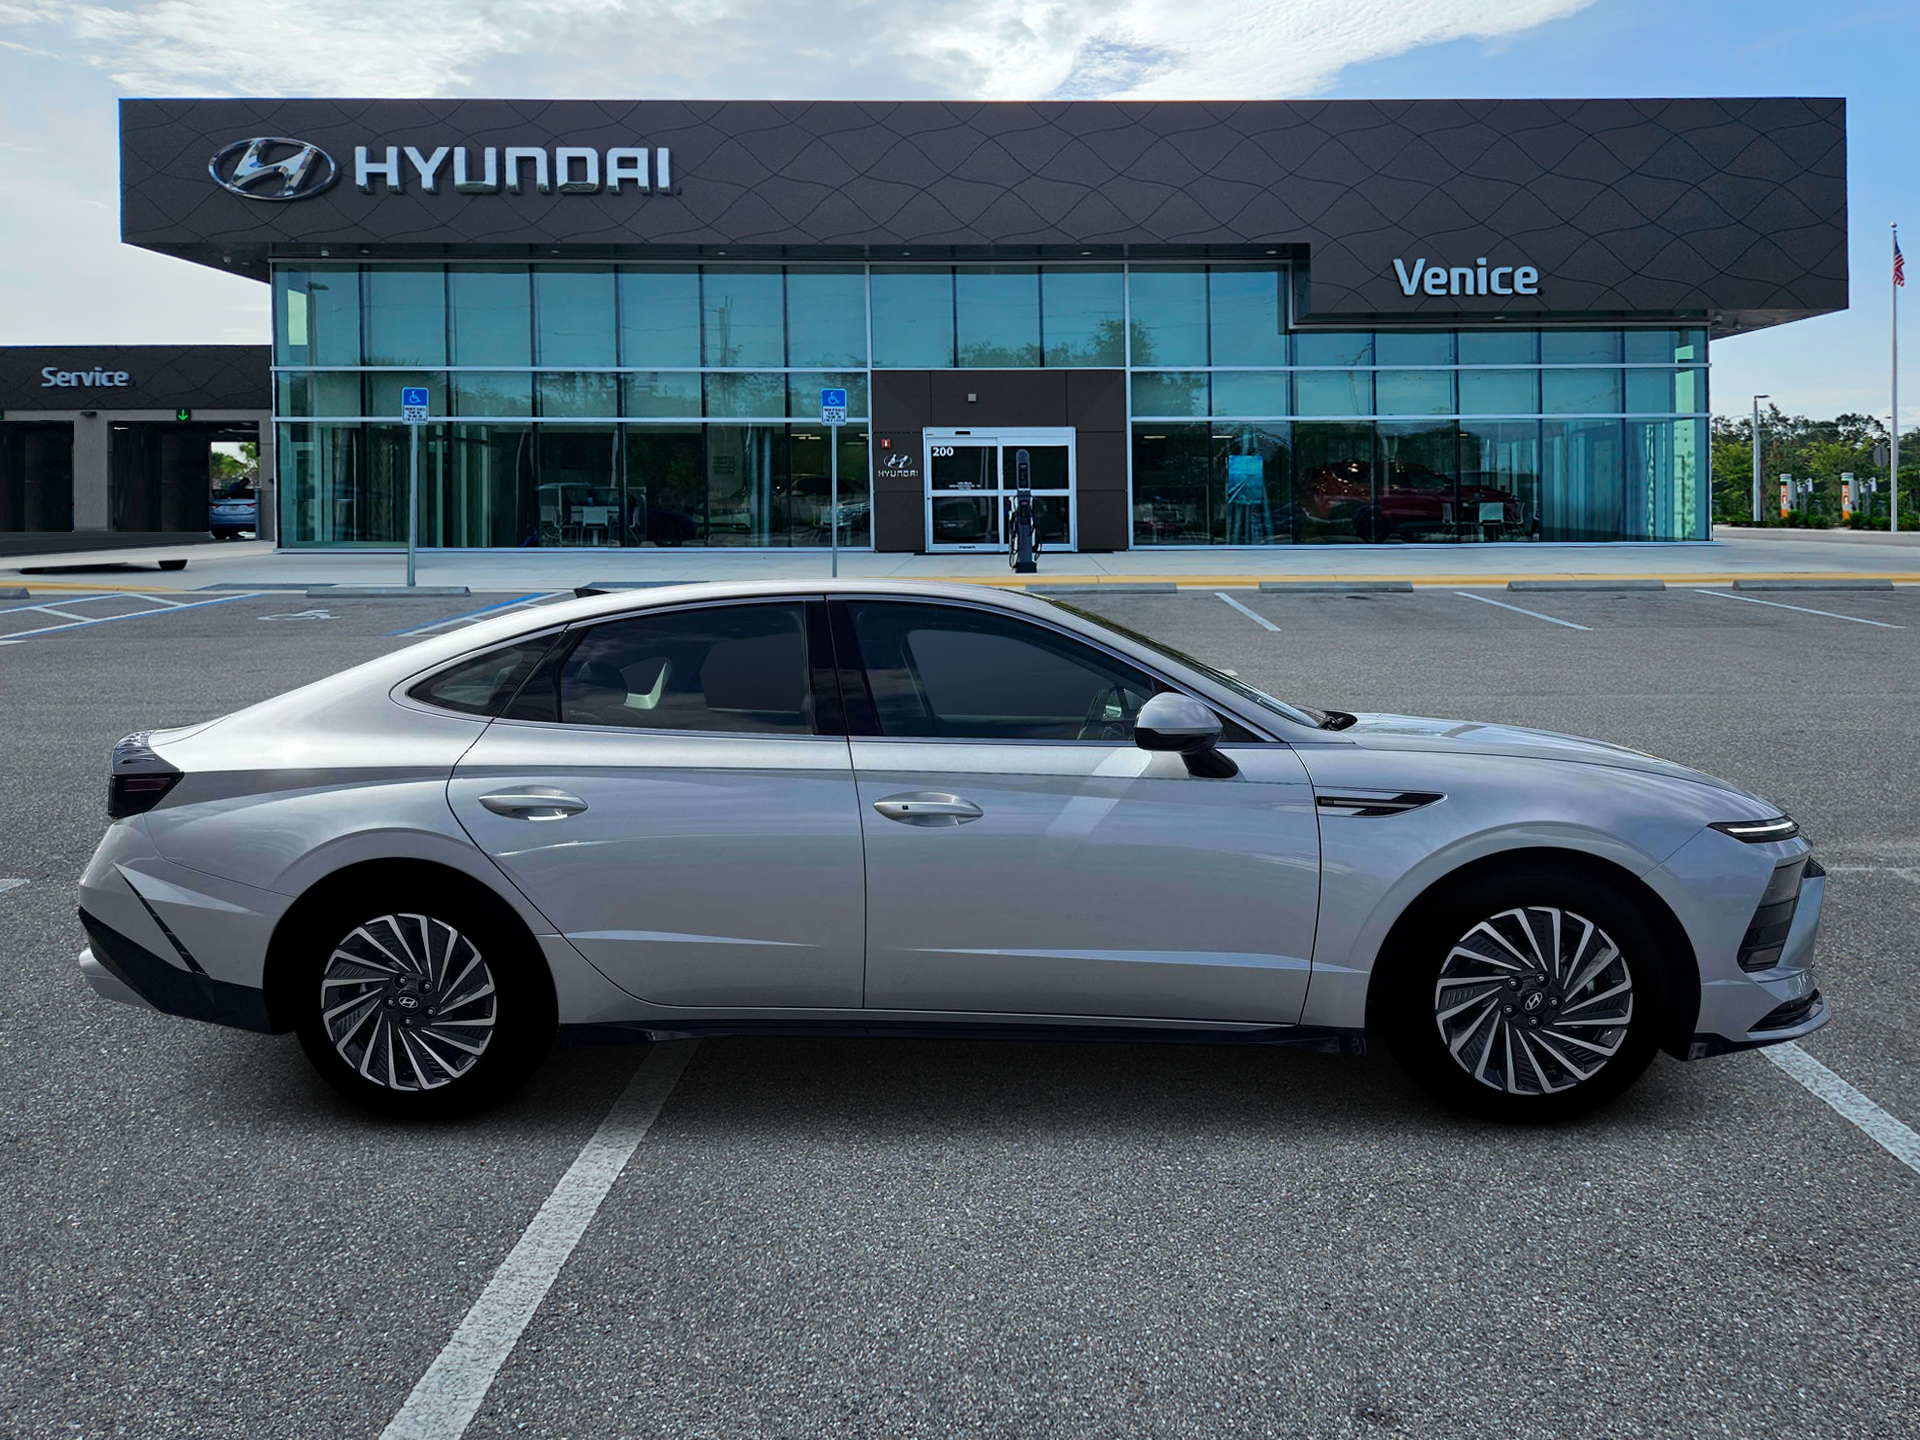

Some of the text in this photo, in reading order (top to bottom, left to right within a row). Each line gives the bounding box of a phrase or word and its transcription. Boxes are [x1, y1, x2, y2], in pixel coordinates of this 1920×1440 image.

[354, 146, 672, 192] HYUNDAI
[1393, 257, 1538, 295] Venice
[41, 367, 129, 386] Service
[932, 446, 954, 457] 200
[877, 469, 919, 477] HYUNDAI
